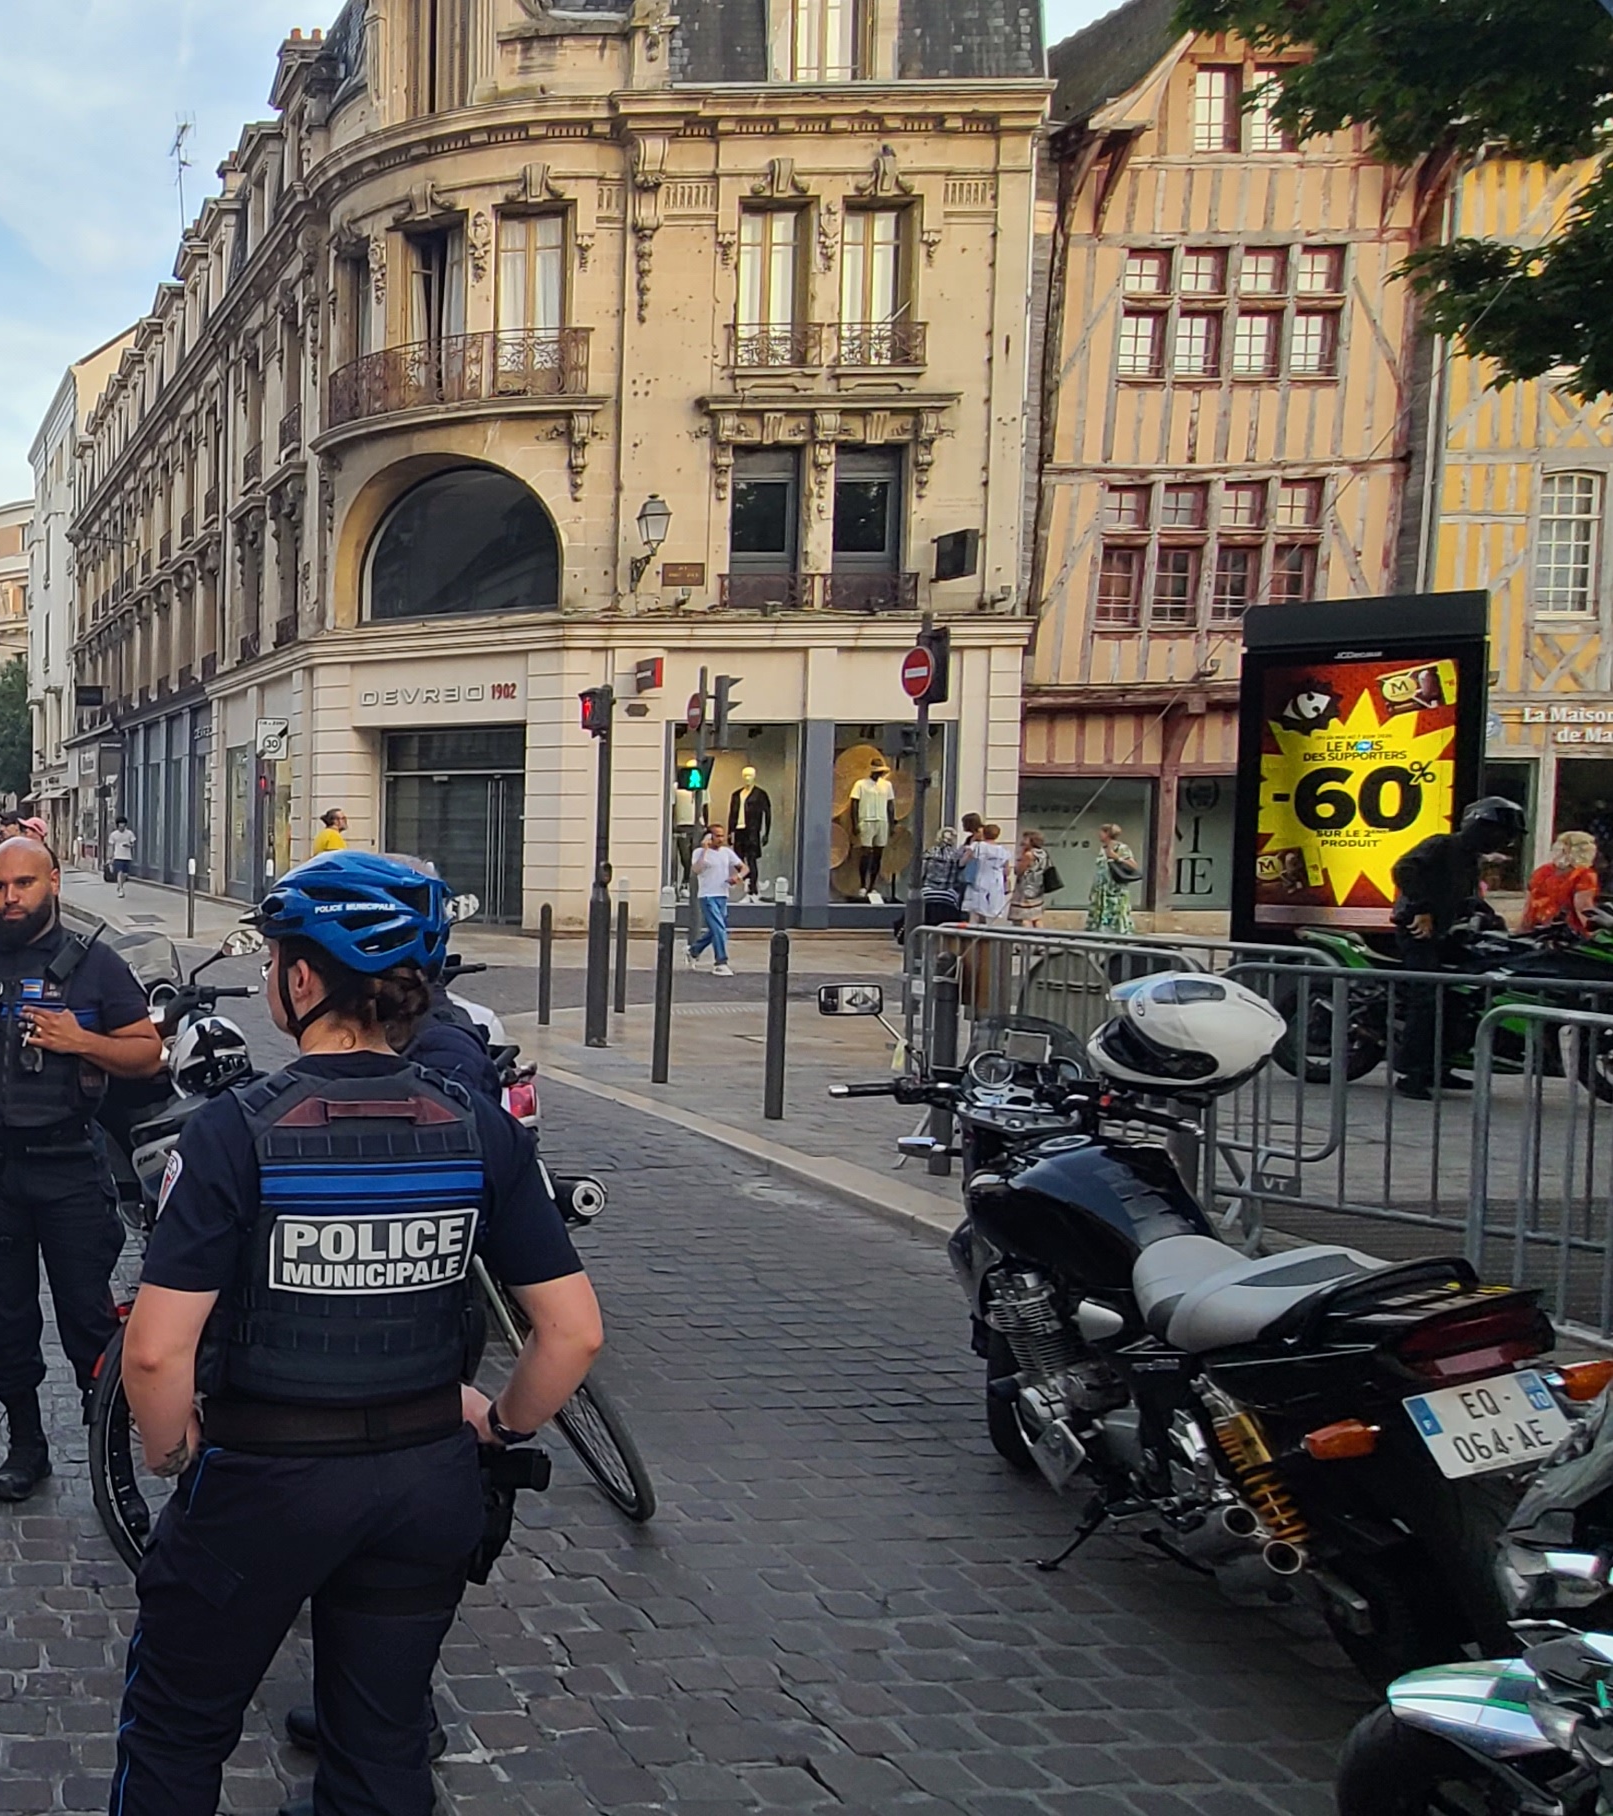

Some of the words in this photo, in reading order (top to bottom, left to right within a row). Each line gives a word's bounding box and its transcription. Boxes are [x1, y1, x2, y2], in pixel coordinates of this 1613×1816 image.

[491, 682, 517, 700] 1902
[1390, 680, 1409, 695] M
[1522, 707, 1546, 723] La
[1557, 726, 1581, 743] de
[266, 739, 278, 748] 30
[1326, 741, 1342, 752] LE
[1303, 753, 1326, 762] DES
[1327, 751, 1407, 761] SUPPORTERS
[1259, 860, 1276, 873] M
[315, 904, 343, 914] POLICE
[346, 903, 396, 911] MUNICIPALE
[1262, 1175, 1288, 1191] VT
[284, 1217, 465, 1262] POLICE
[282, 1255, 461, 1288] MUNICIPALE
[1529, 1393, 1549, 1411] 10
[1453, 1419, 1553, 1464] 064-AE
